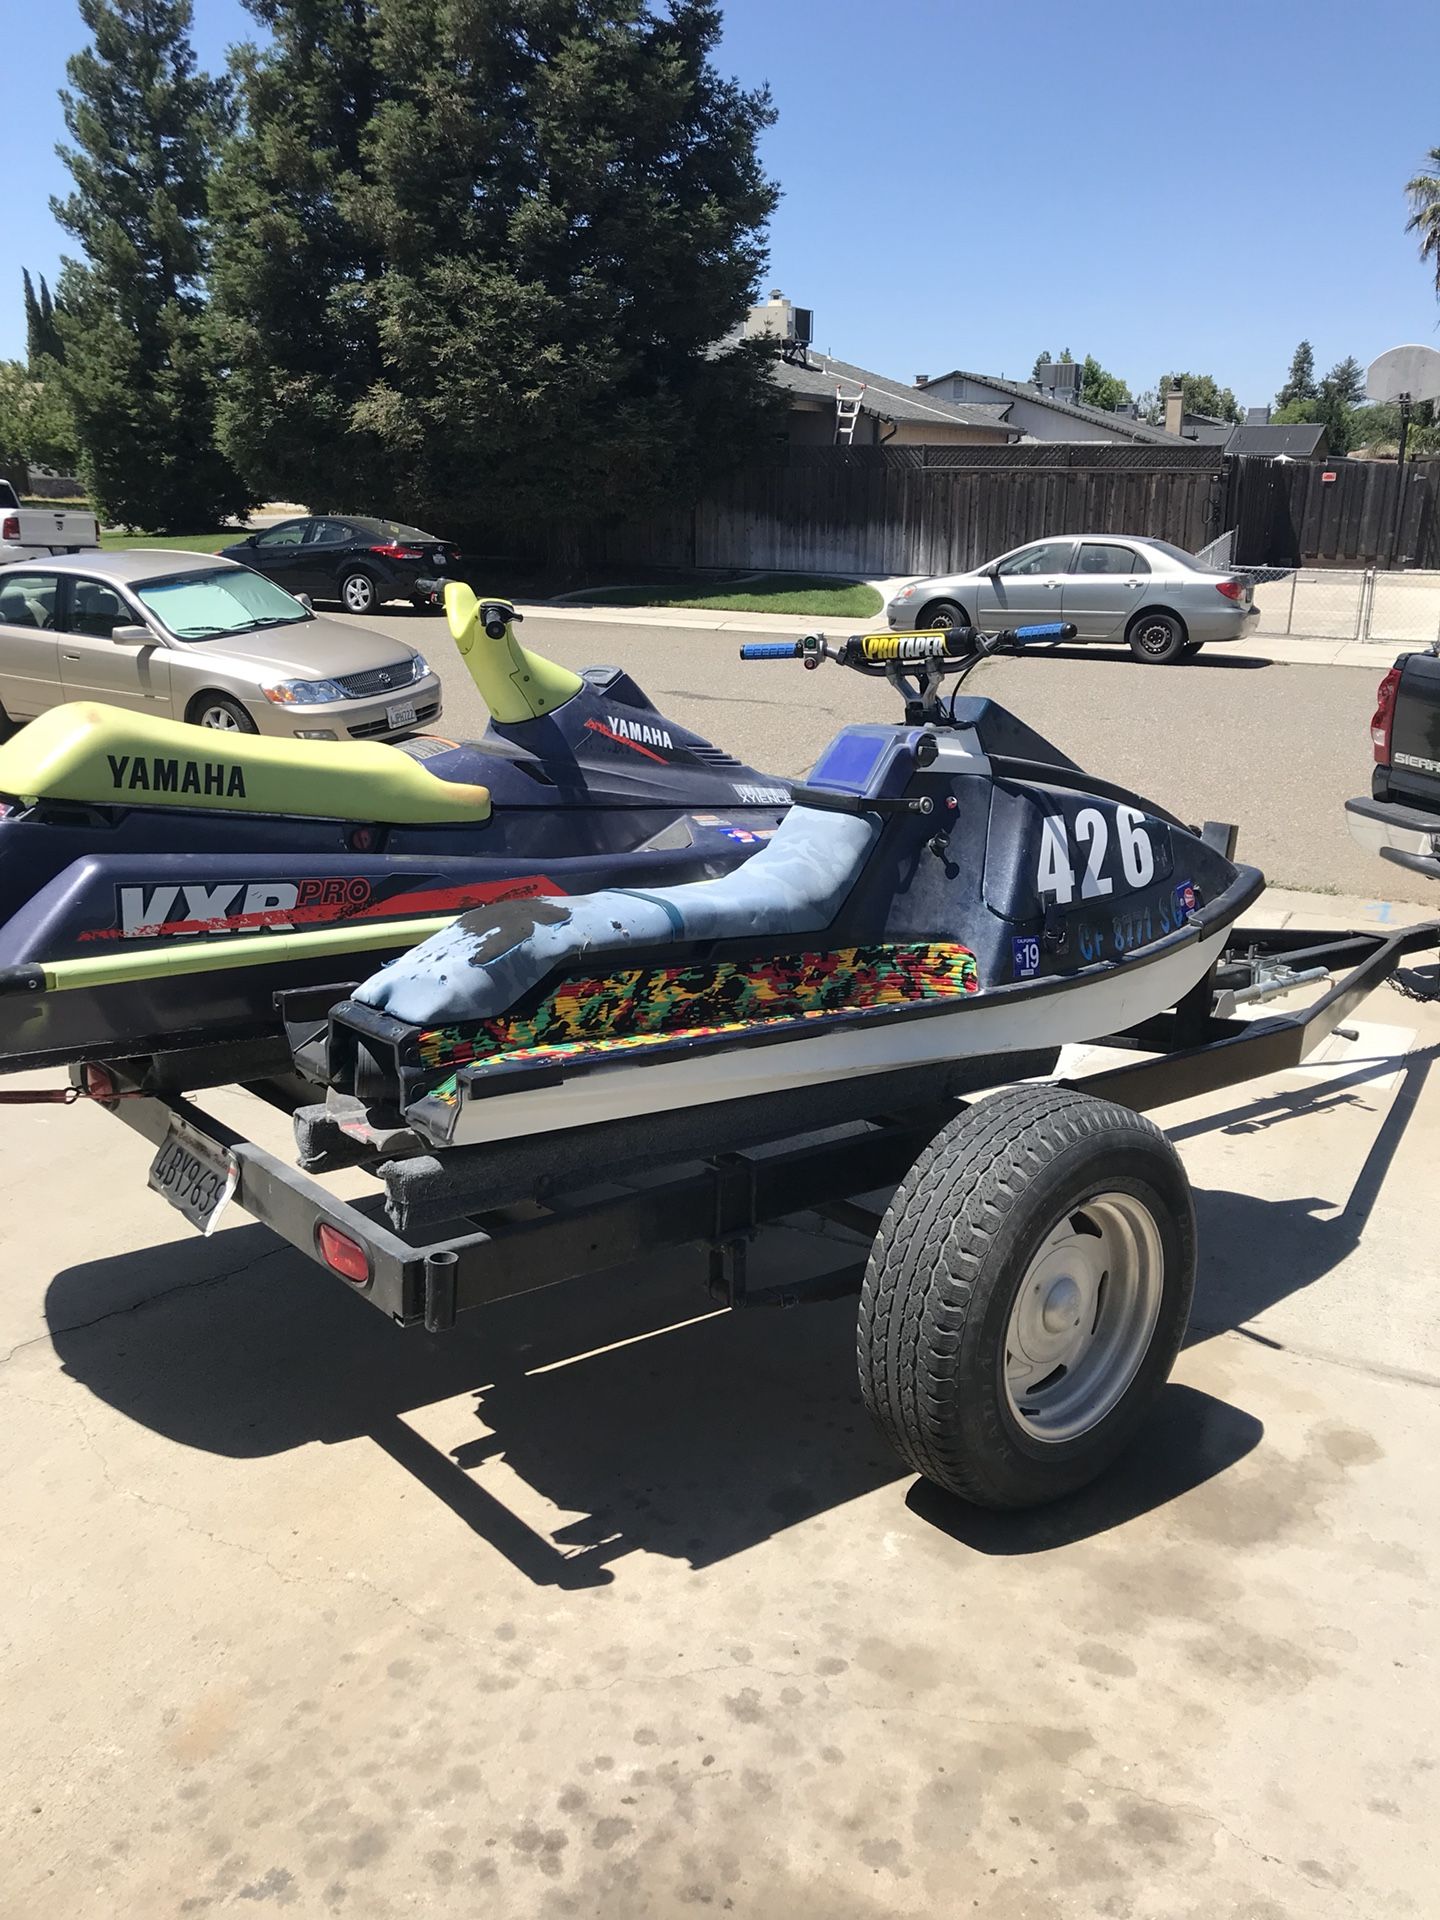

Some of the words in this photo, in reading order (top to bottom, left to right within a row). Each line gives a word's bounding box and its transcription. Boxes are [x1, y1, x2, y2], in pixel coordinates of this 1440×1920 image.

[607, 715, 674, 750] YAMAHA
[106, 754, 247, 798] YAMAHA
[1037, 804, 1155, 904] 426
[120, 882, 299, 939] VXR
[297, 876, 372, 906] PRO
[1022, 943, 1040, 969] 19
